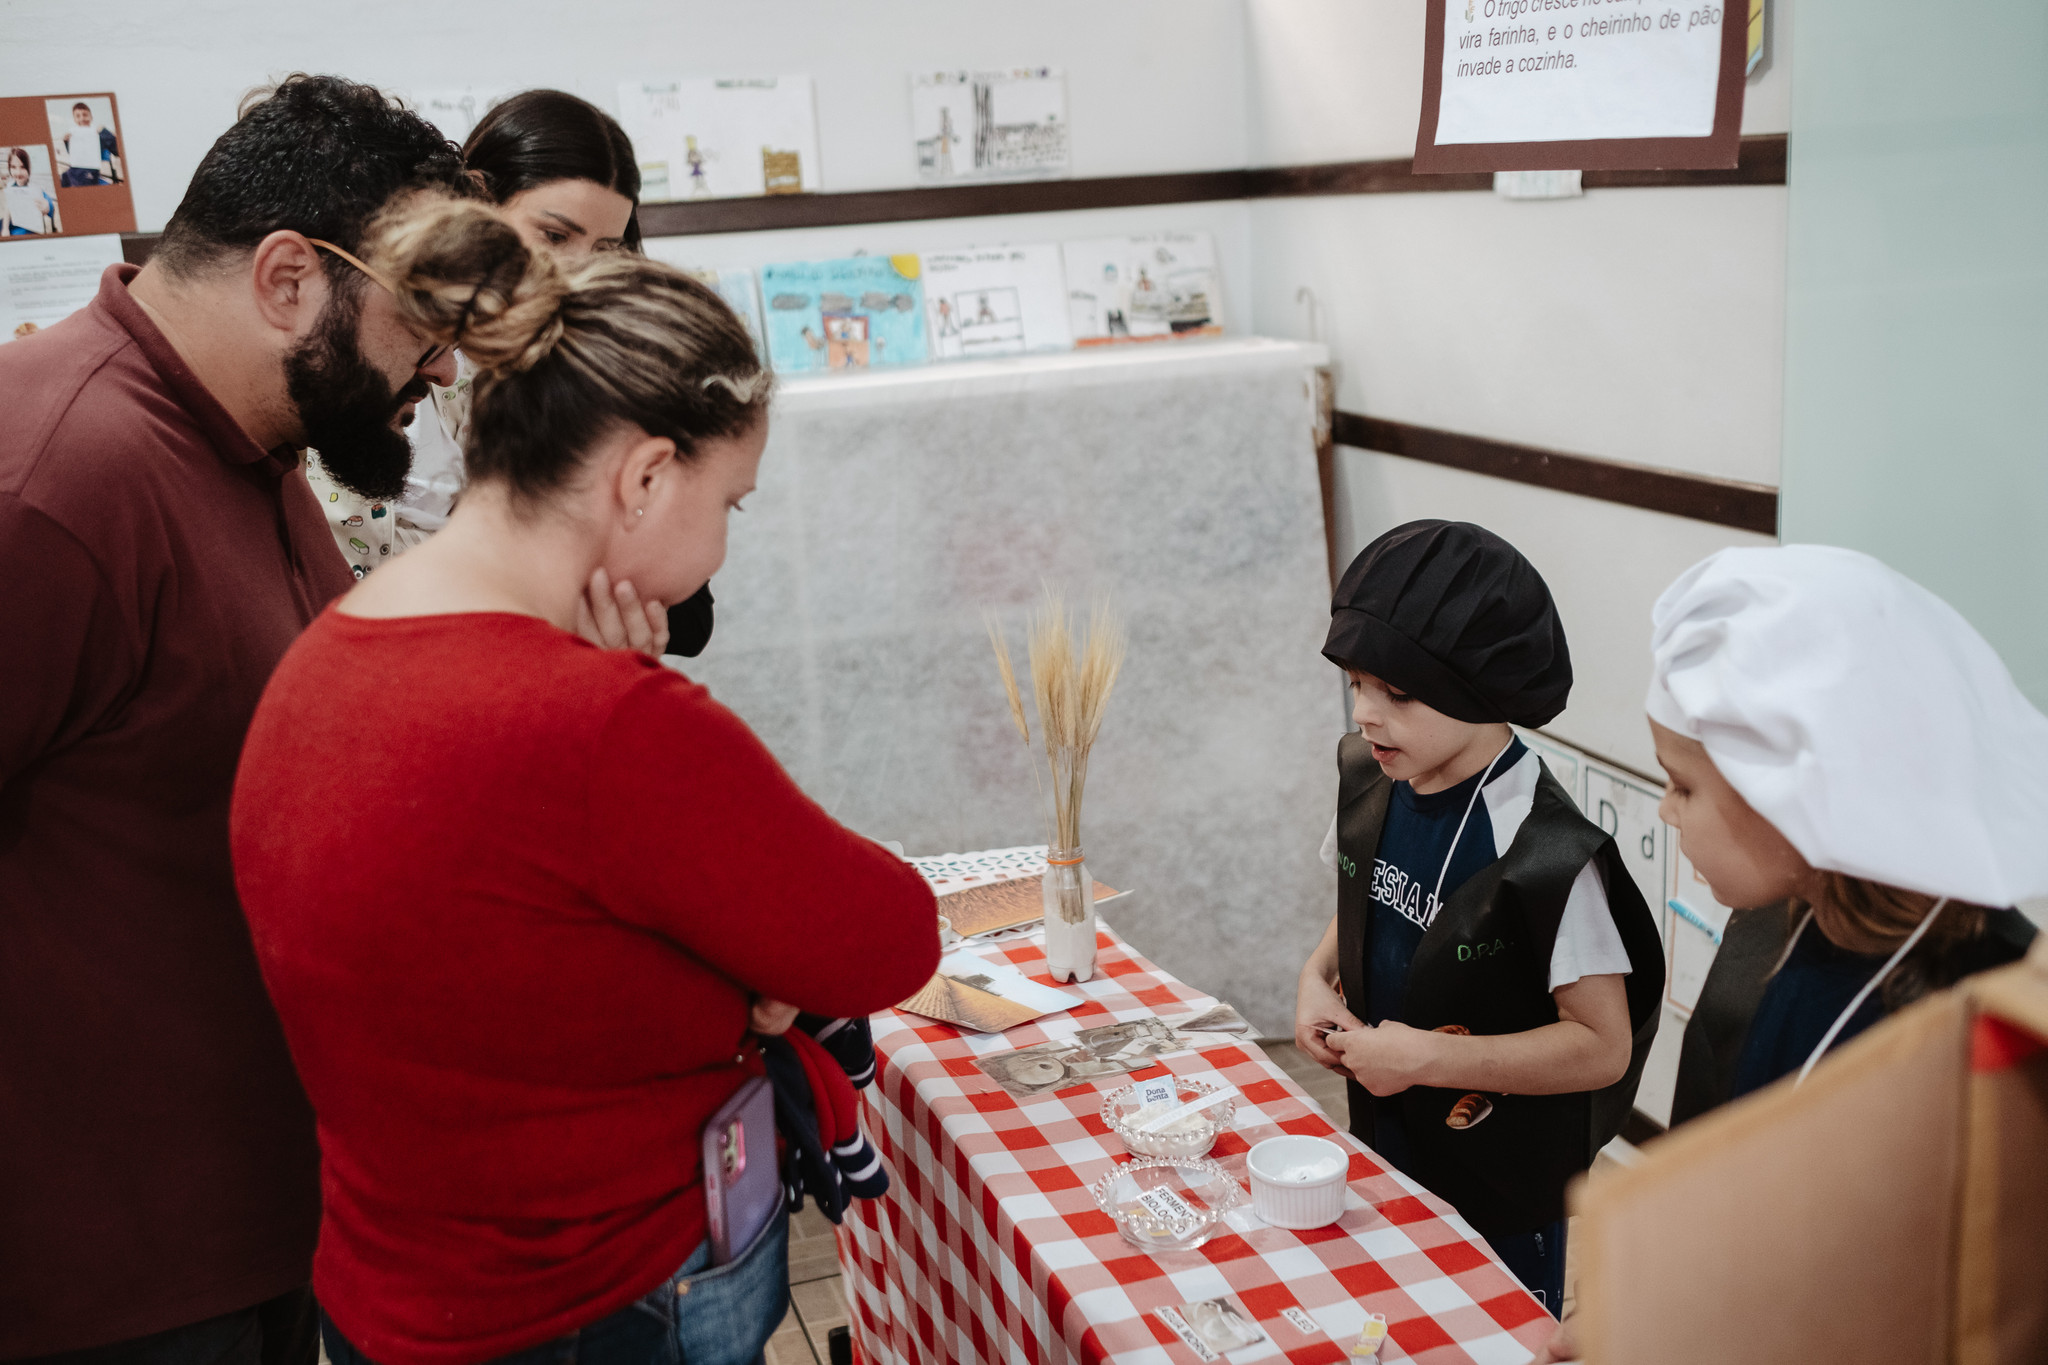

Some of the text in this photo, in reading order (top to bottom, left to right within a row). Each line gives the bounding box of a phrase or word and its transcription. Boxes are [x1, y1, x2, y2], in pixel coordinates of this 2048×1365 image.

[1484, 0, 1496, 18] O
[1498, 0, 1528, 20] trigo
[1459, 5, 1721, 49] vira farinha, e o cheirinho de pão
[1457, 50, 1578, 77] invade a cozinha.
[1145, 1087, 1166, 1097] Dona
